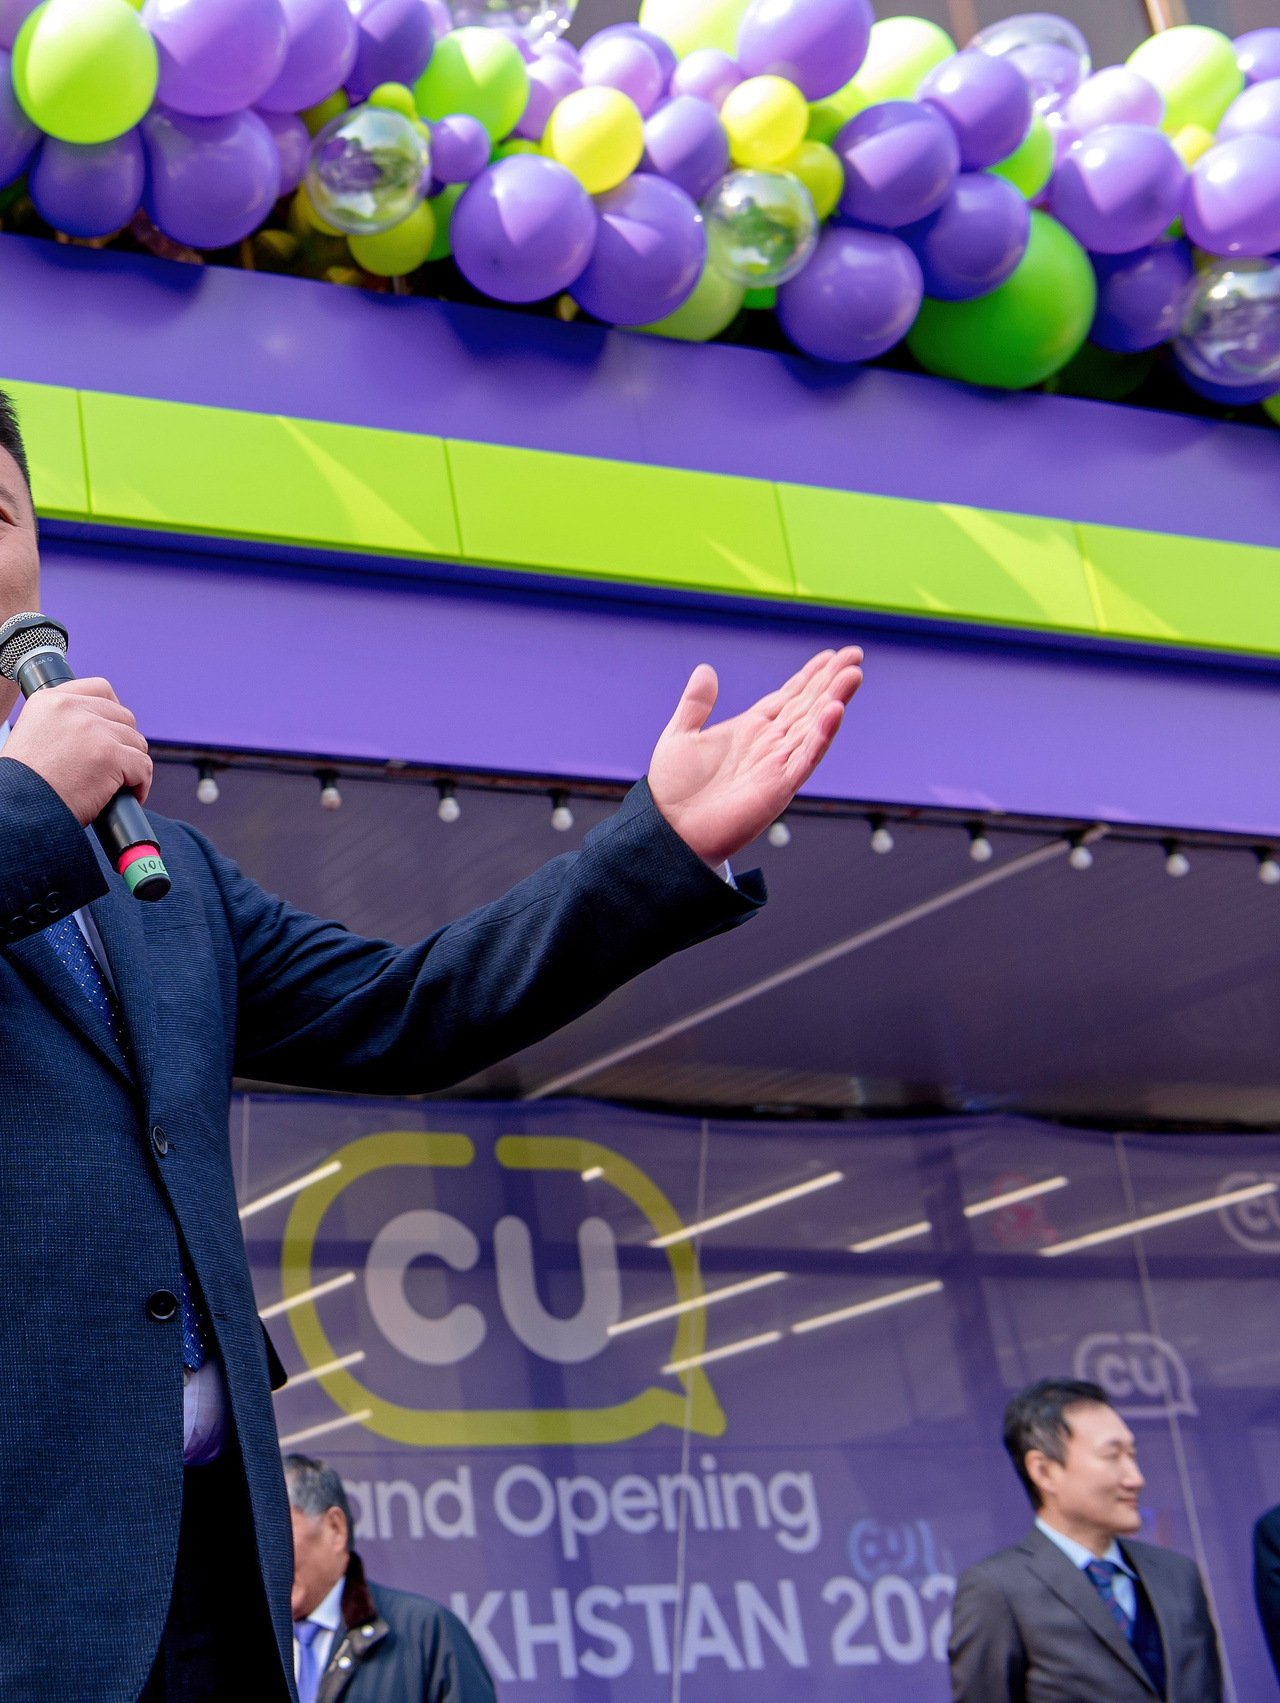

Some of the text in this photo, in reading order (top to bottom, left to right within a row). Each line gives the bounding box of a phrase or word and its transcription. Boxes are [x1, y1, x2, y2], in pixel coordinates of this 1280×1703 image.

[364, 1208, 622, 1366] CU
[1096, 1353, 1166, 1397] CU
[342, 1464, 478, 1541] and
[493, 1454, 820, 1560] Opening
[450, 1573, 958, 1683] KHSTAN 202
